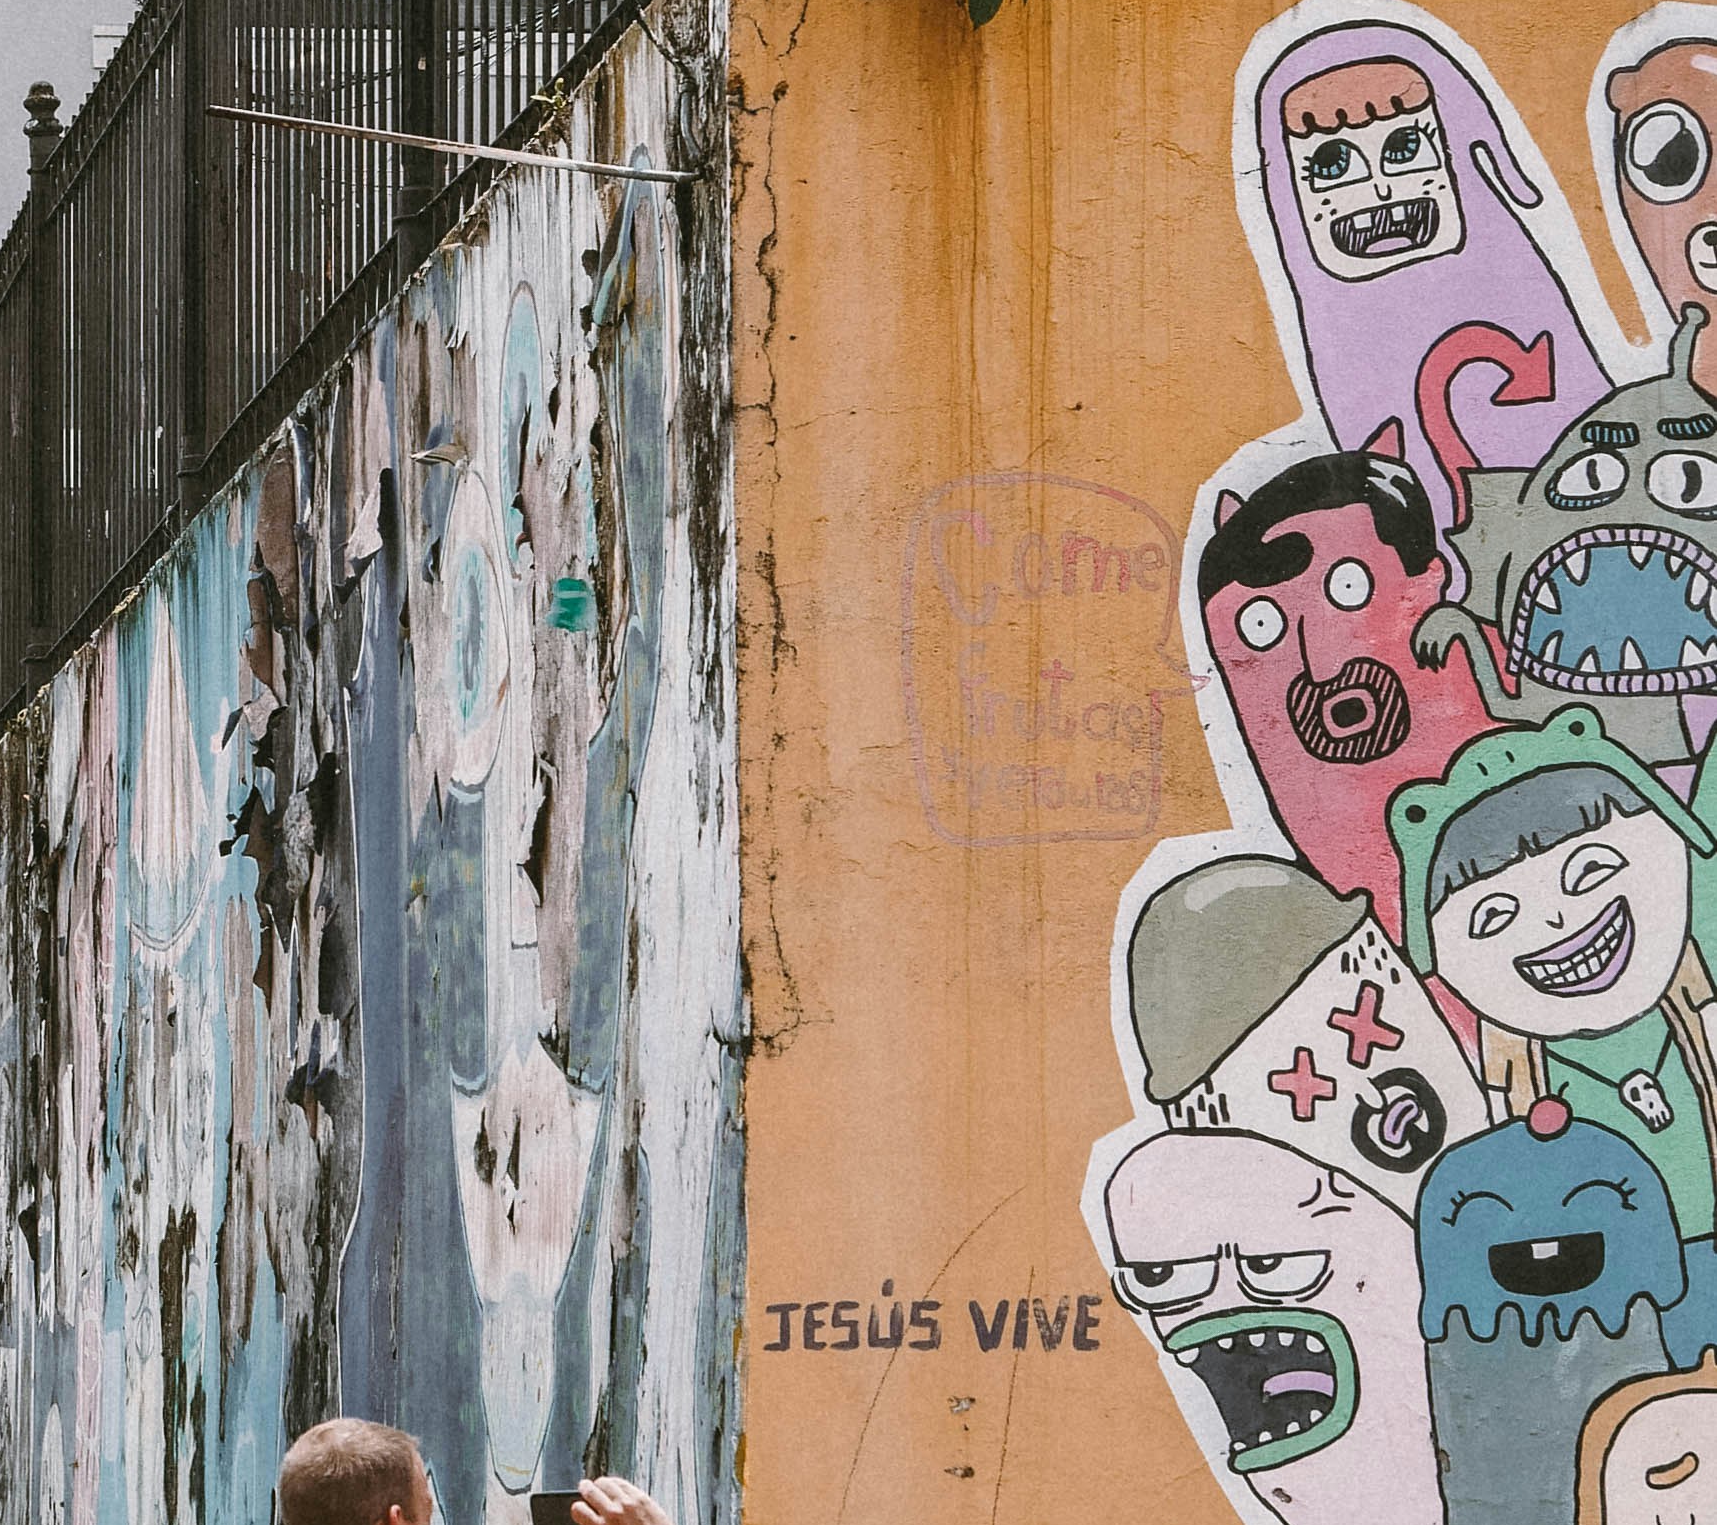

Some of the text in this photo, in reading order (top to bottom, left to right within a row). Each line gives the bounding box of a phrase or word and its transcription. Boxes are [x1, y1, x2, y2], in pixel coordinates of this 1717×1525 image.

[930, 509, 1165, 626] Come
[763, 1278, 1103, 1352] JESÚS VIVE
